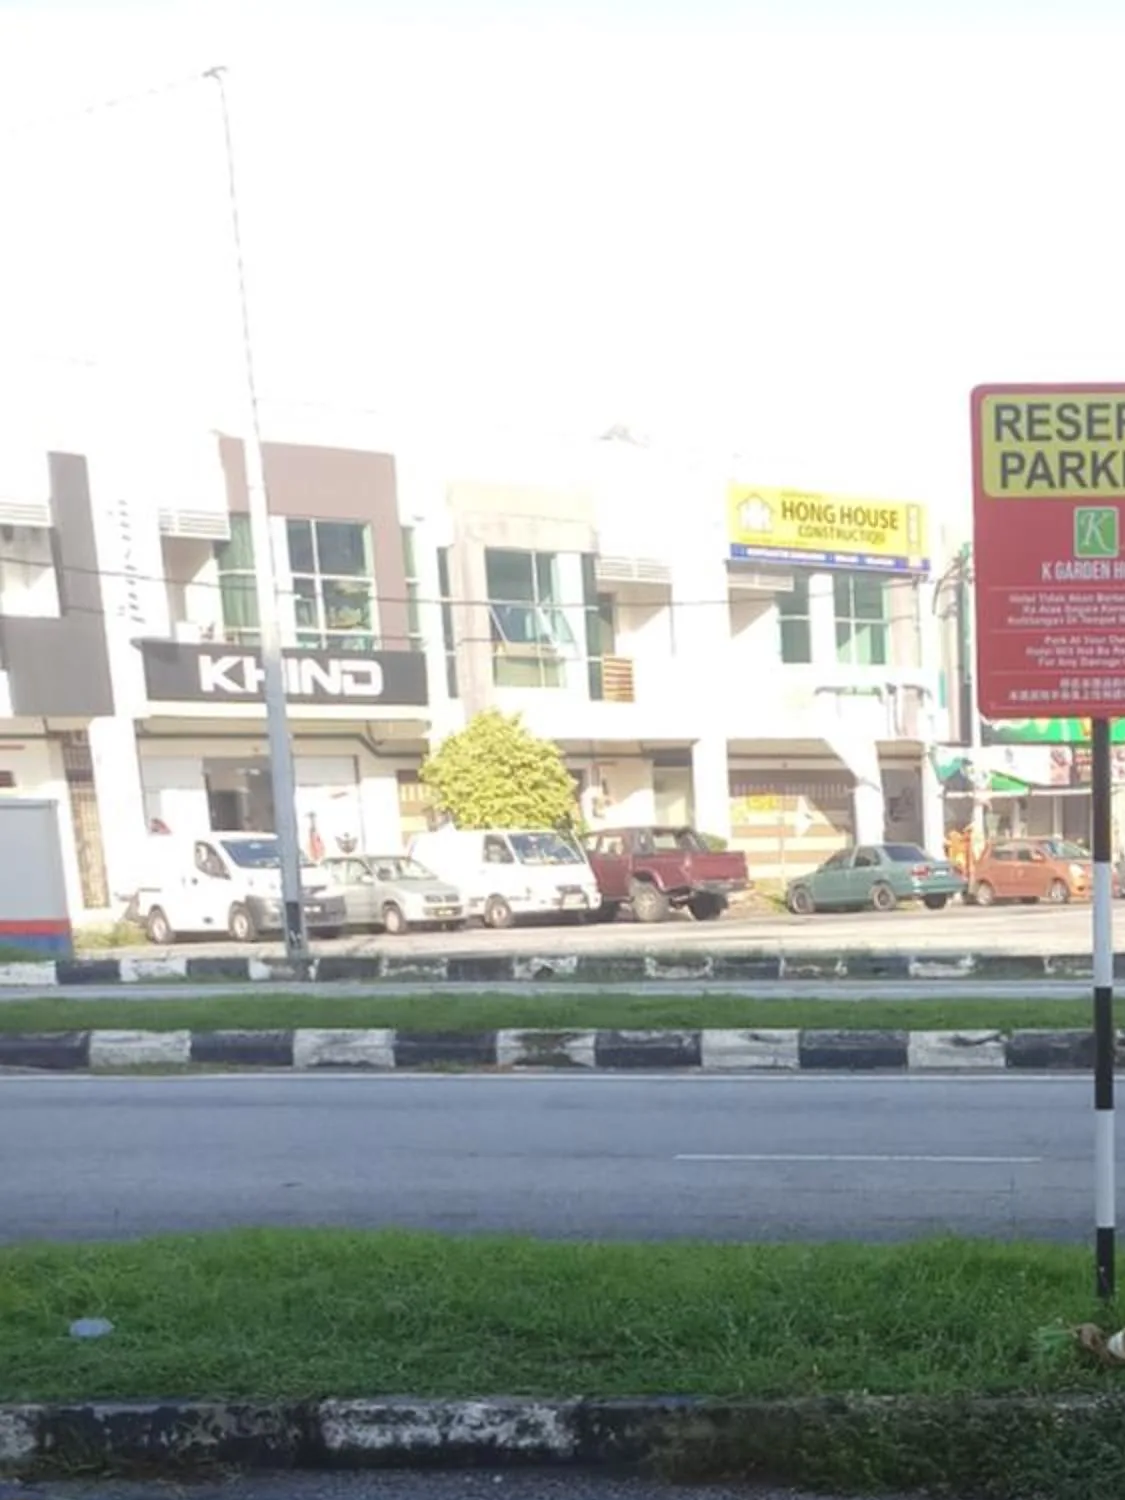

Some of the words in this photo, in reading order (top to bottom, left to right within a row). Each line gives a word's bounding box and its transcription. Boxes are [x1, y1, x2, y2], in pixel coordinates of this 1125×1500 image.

[781, 500, 837, 524] HONG
[840, 506, 899, 531] HOUSE
[1041, 561, 1053, 581] K
[1055, 561, 1110, 580] GARDEN
[198, 655, 383, 696] KHIND
